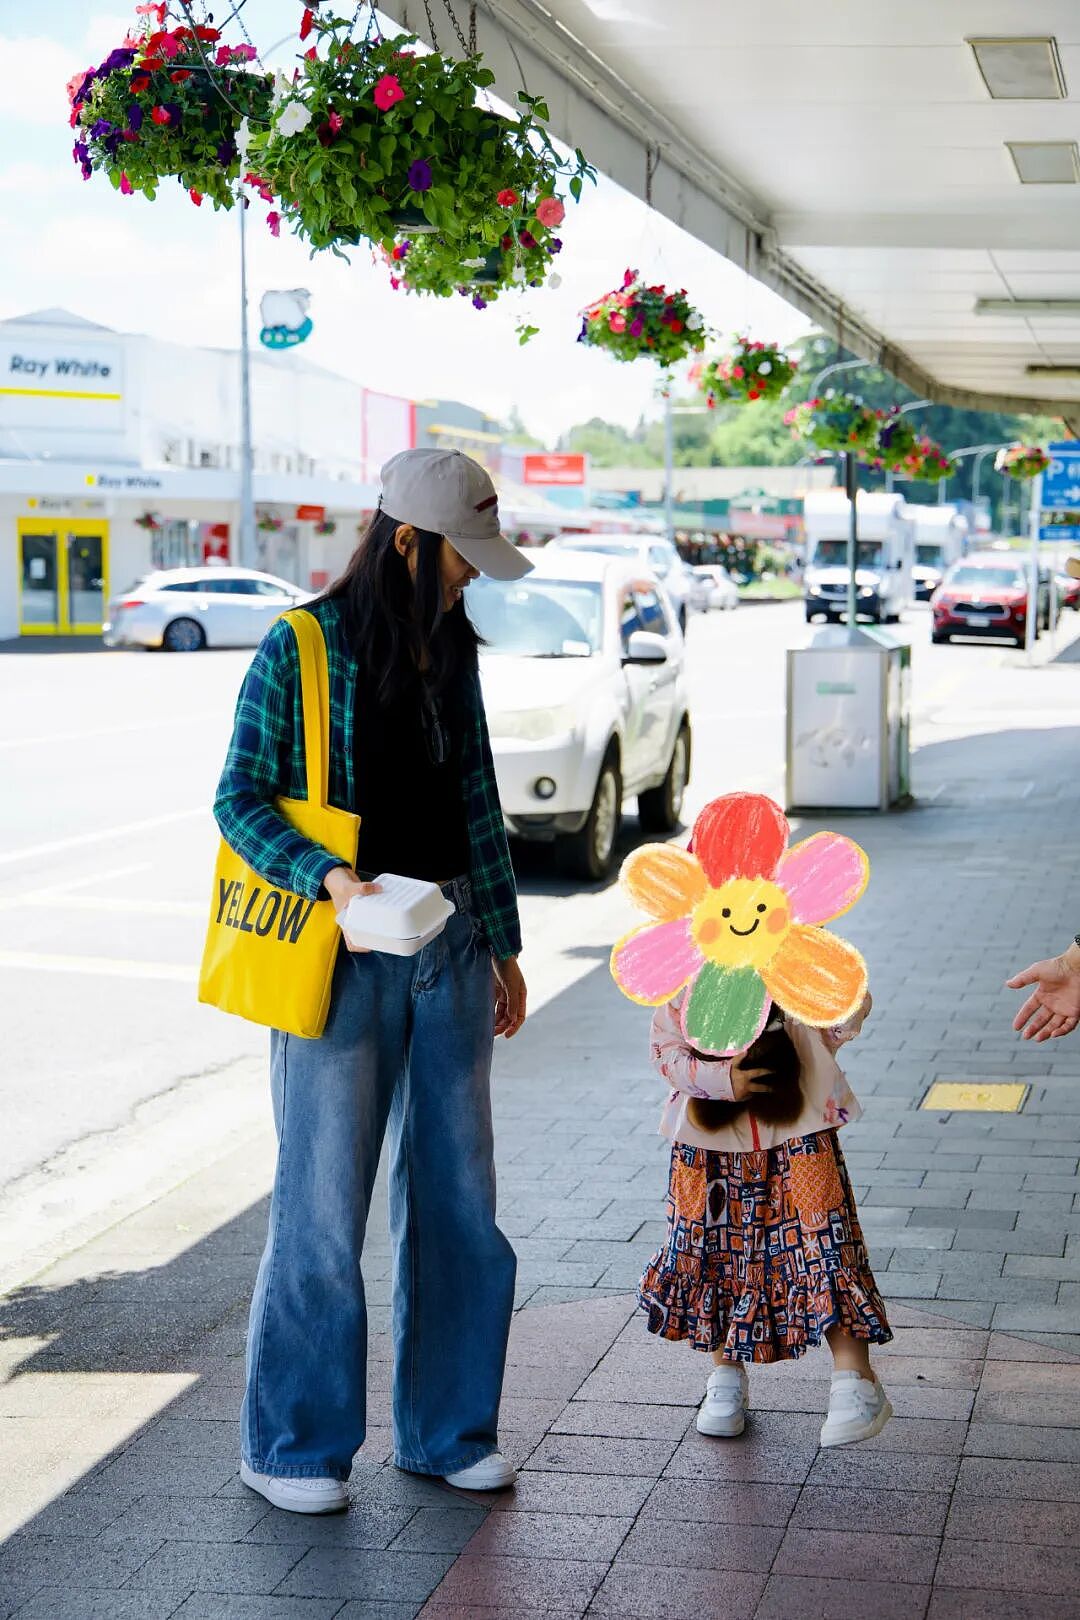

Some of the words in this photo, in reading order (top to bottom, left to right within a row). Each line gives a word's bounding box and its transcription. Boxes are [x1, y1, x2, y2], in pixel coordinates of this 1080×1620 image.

[10, 355, 48, 379] Ray
[55, 358, 111, 377] White
[216, 878, 315, 944] YELLOW
